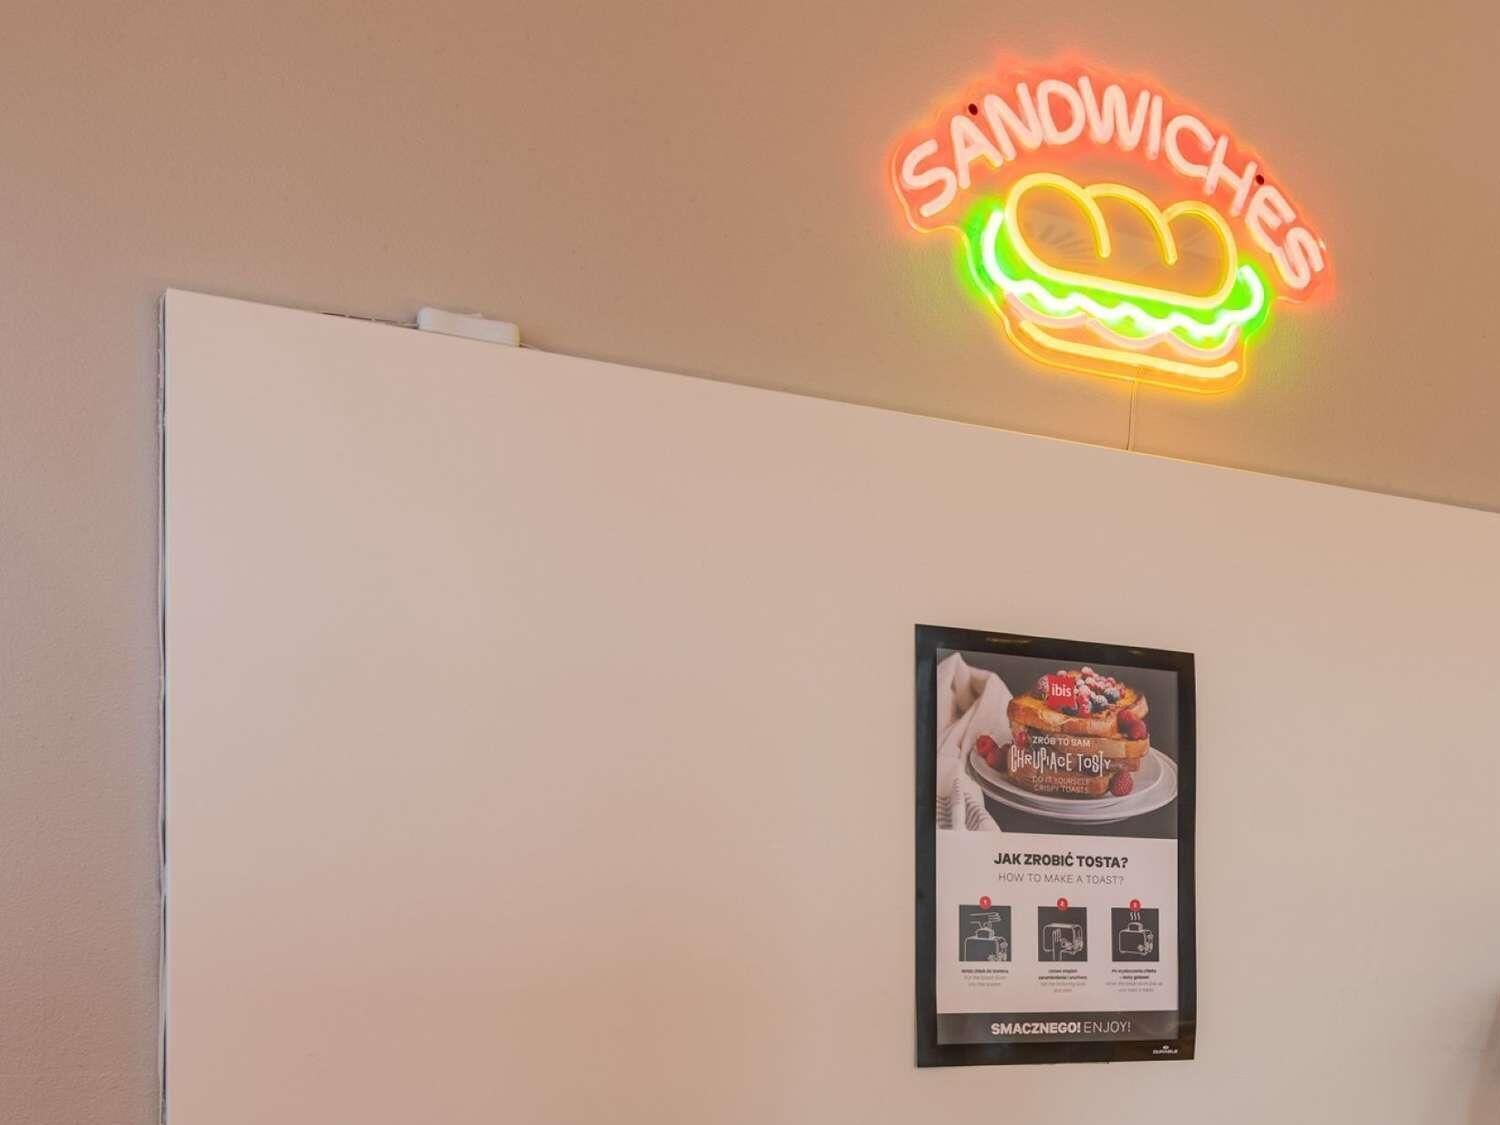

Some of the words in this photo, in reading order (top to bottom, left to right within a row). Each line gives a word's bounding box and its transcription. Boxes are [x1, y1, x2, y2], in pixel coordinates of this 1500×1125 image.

[901, 75, 1325, 289] SANDWICHES
[1051, 683, 1072, 697] ibis
[1032, 734, 1056, 745] ZRÓB
[1071, 738, 1091, 747] SAM
[1077, 751, 1111, 777] TOSTY
[994, 852, 1021, 865] JAK
[1023, 852, 1074, 867] ZROBIĆ
[1076, 855, 1129, 868] TOSTA?
[998, 872, 1025, 882] HOW
[1029, 873, 1041, 883] TO
[1044, 874, 1074, 884] MAKE
[1076, 875, 1084, 884] A
[1086, 875, 1124, 885] TOAST?
[991, 1022, 1081, 1035] SMACZNEGO!
[1083, 1020, 1131, 1034] ENJOY!
